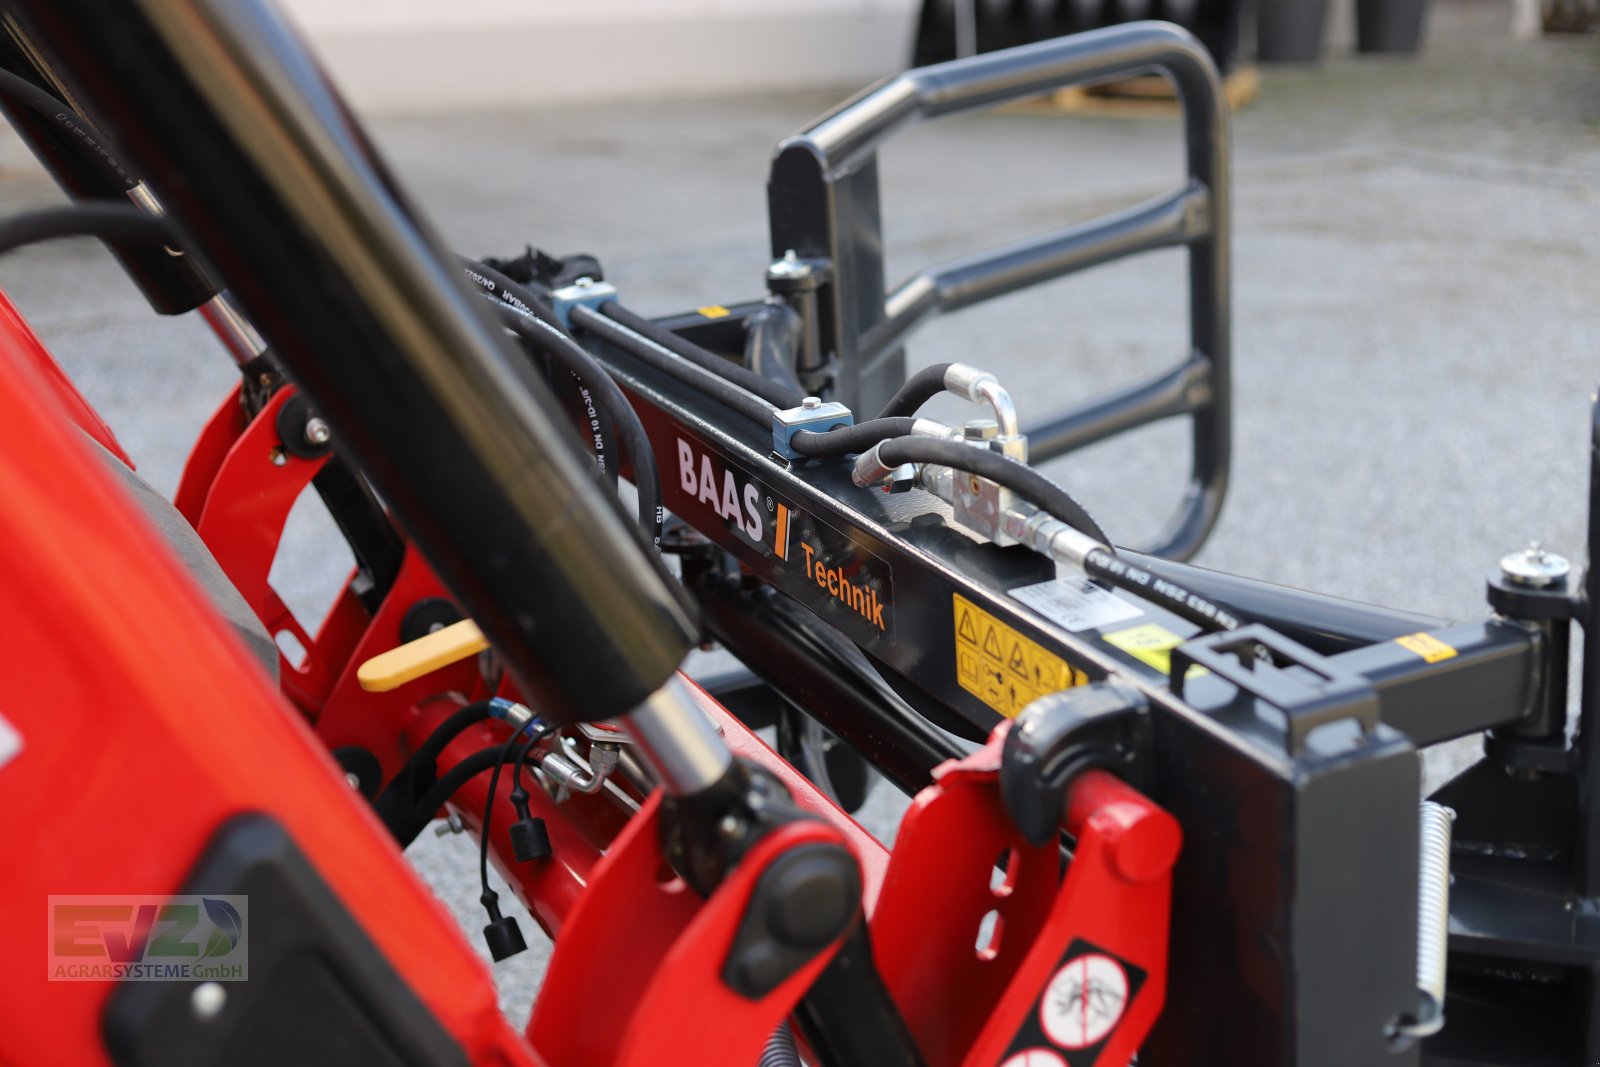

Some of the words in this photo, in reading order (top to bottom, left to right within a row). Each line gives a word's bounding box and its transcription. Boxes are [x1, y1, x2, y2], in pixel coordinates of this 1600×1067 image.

[591, 420, 600, 432] 10
[594, 434, 604, 450] DN
[677, 437, 763, 542] BAAS
[656, 506, 663, 524] HB
[1125, 567, 1151, 586] DN
[801, 541, 886, 632] Technik
[1215, 610, 1239, 632] EN
